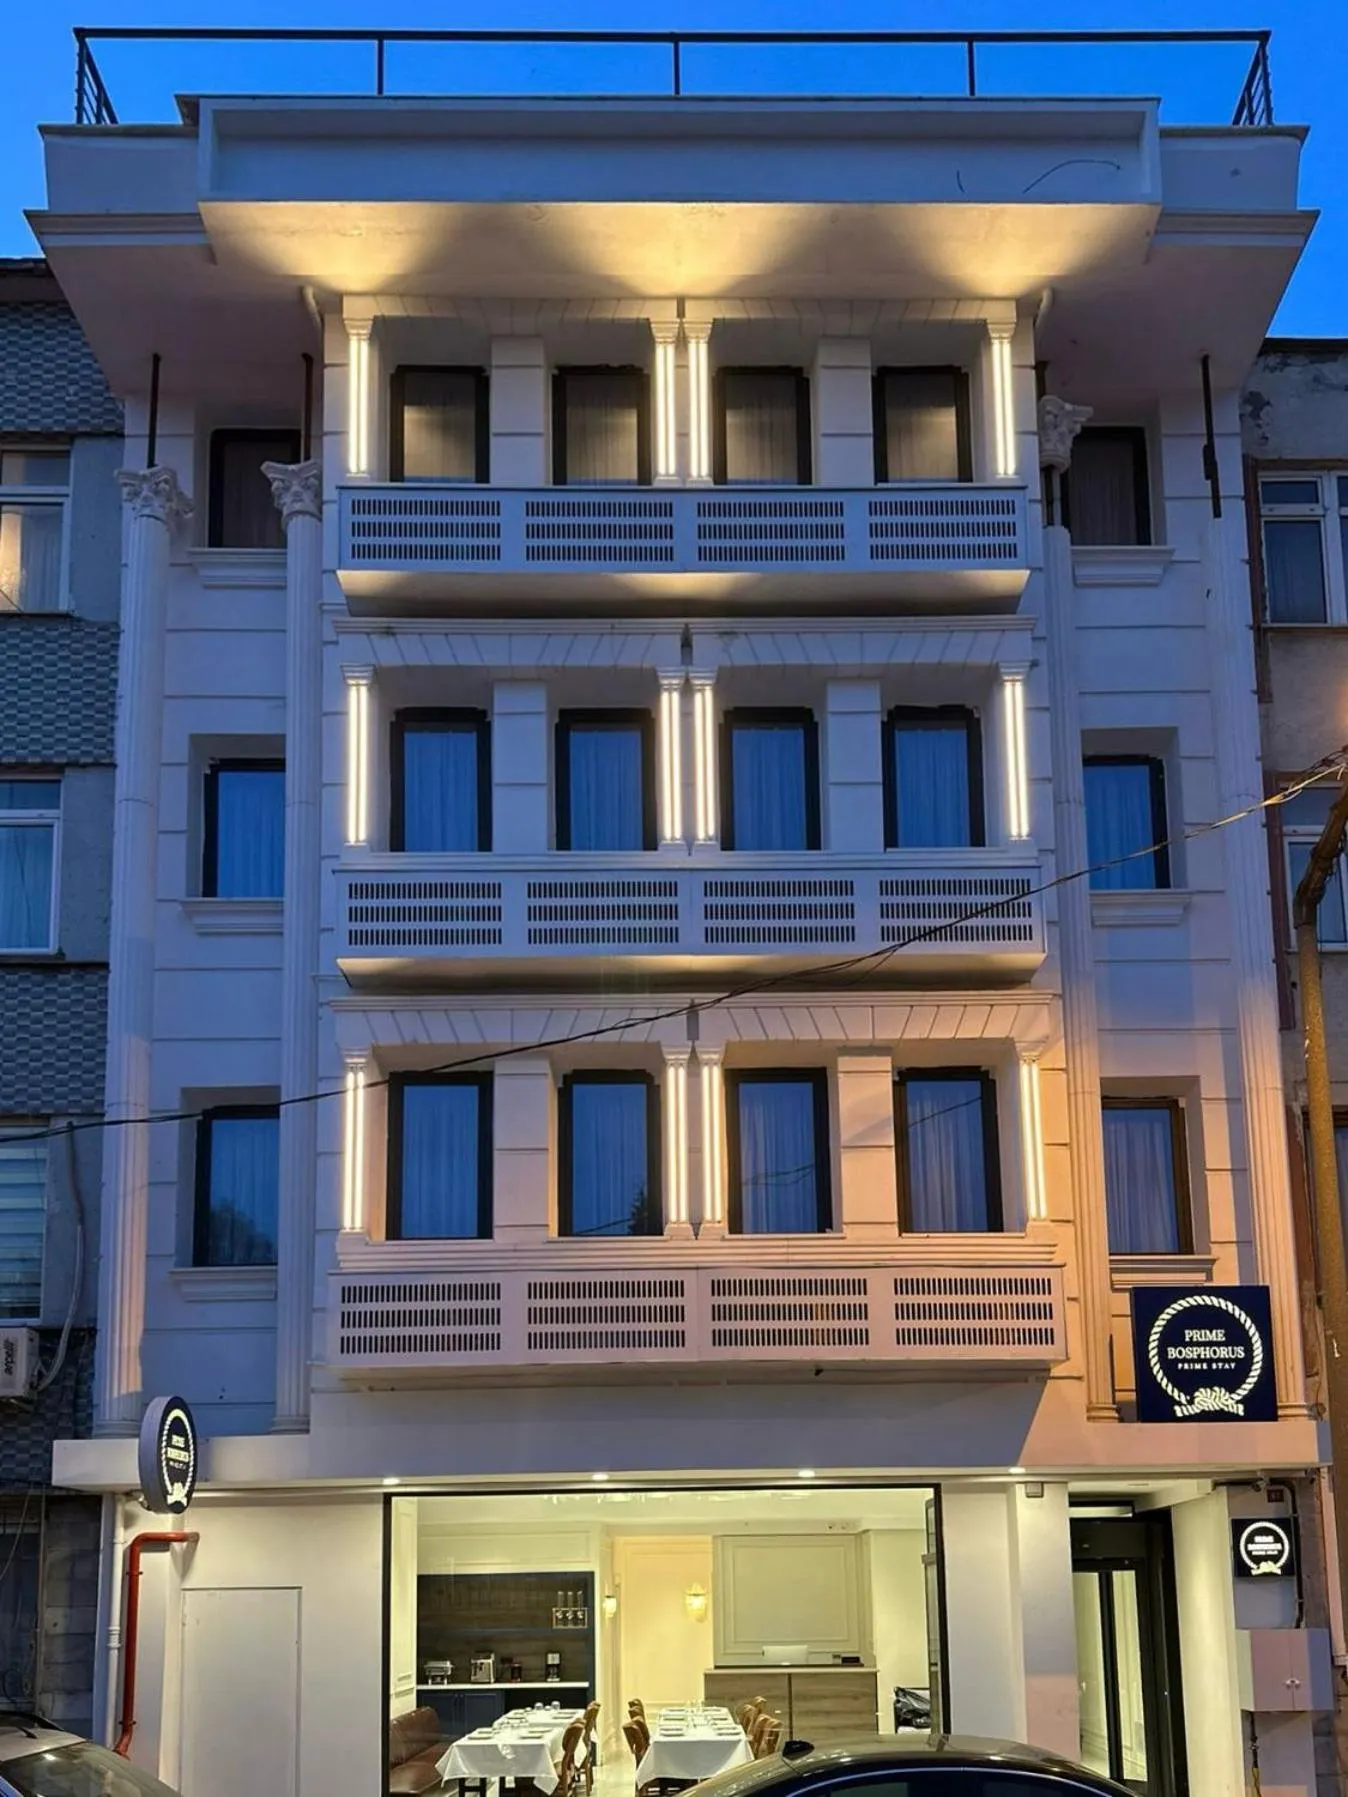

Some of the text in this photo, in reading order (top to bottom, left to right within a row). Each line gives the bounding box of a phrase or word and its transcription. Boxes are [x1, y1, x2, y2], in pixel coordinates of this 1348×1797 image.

[1184, 1329, 1226, 1342] PRIME
[1167, 1346, 1245, 1359] BOSPHORUS
[1177, 1362, 1236, 1370] PRIME STAY
